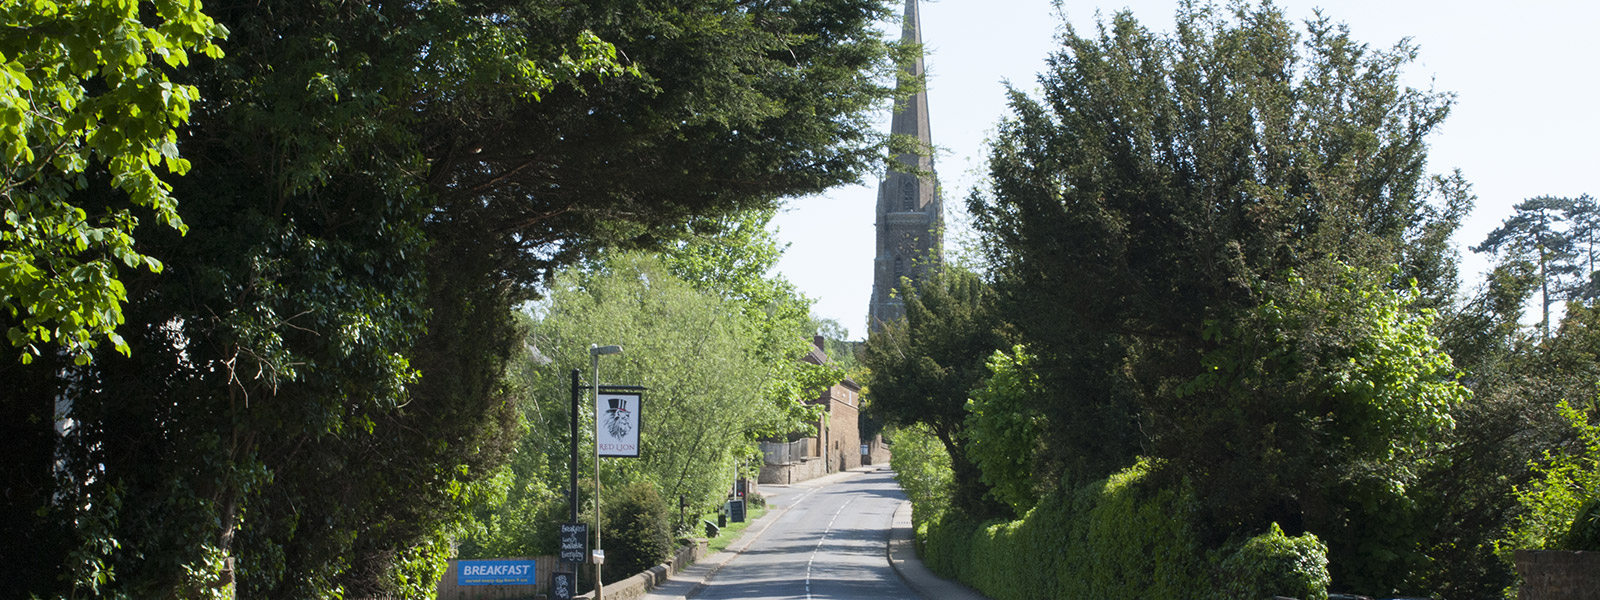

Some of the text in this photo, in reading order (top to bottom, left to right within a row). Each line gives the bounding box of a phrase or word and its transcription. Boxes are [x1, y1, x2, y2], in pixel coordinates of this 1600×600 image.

[616, 443, 635, 451] LION
[561, 524, 585, 534] Breakfast
[463, 565, 531, 576] BREAKFAST
